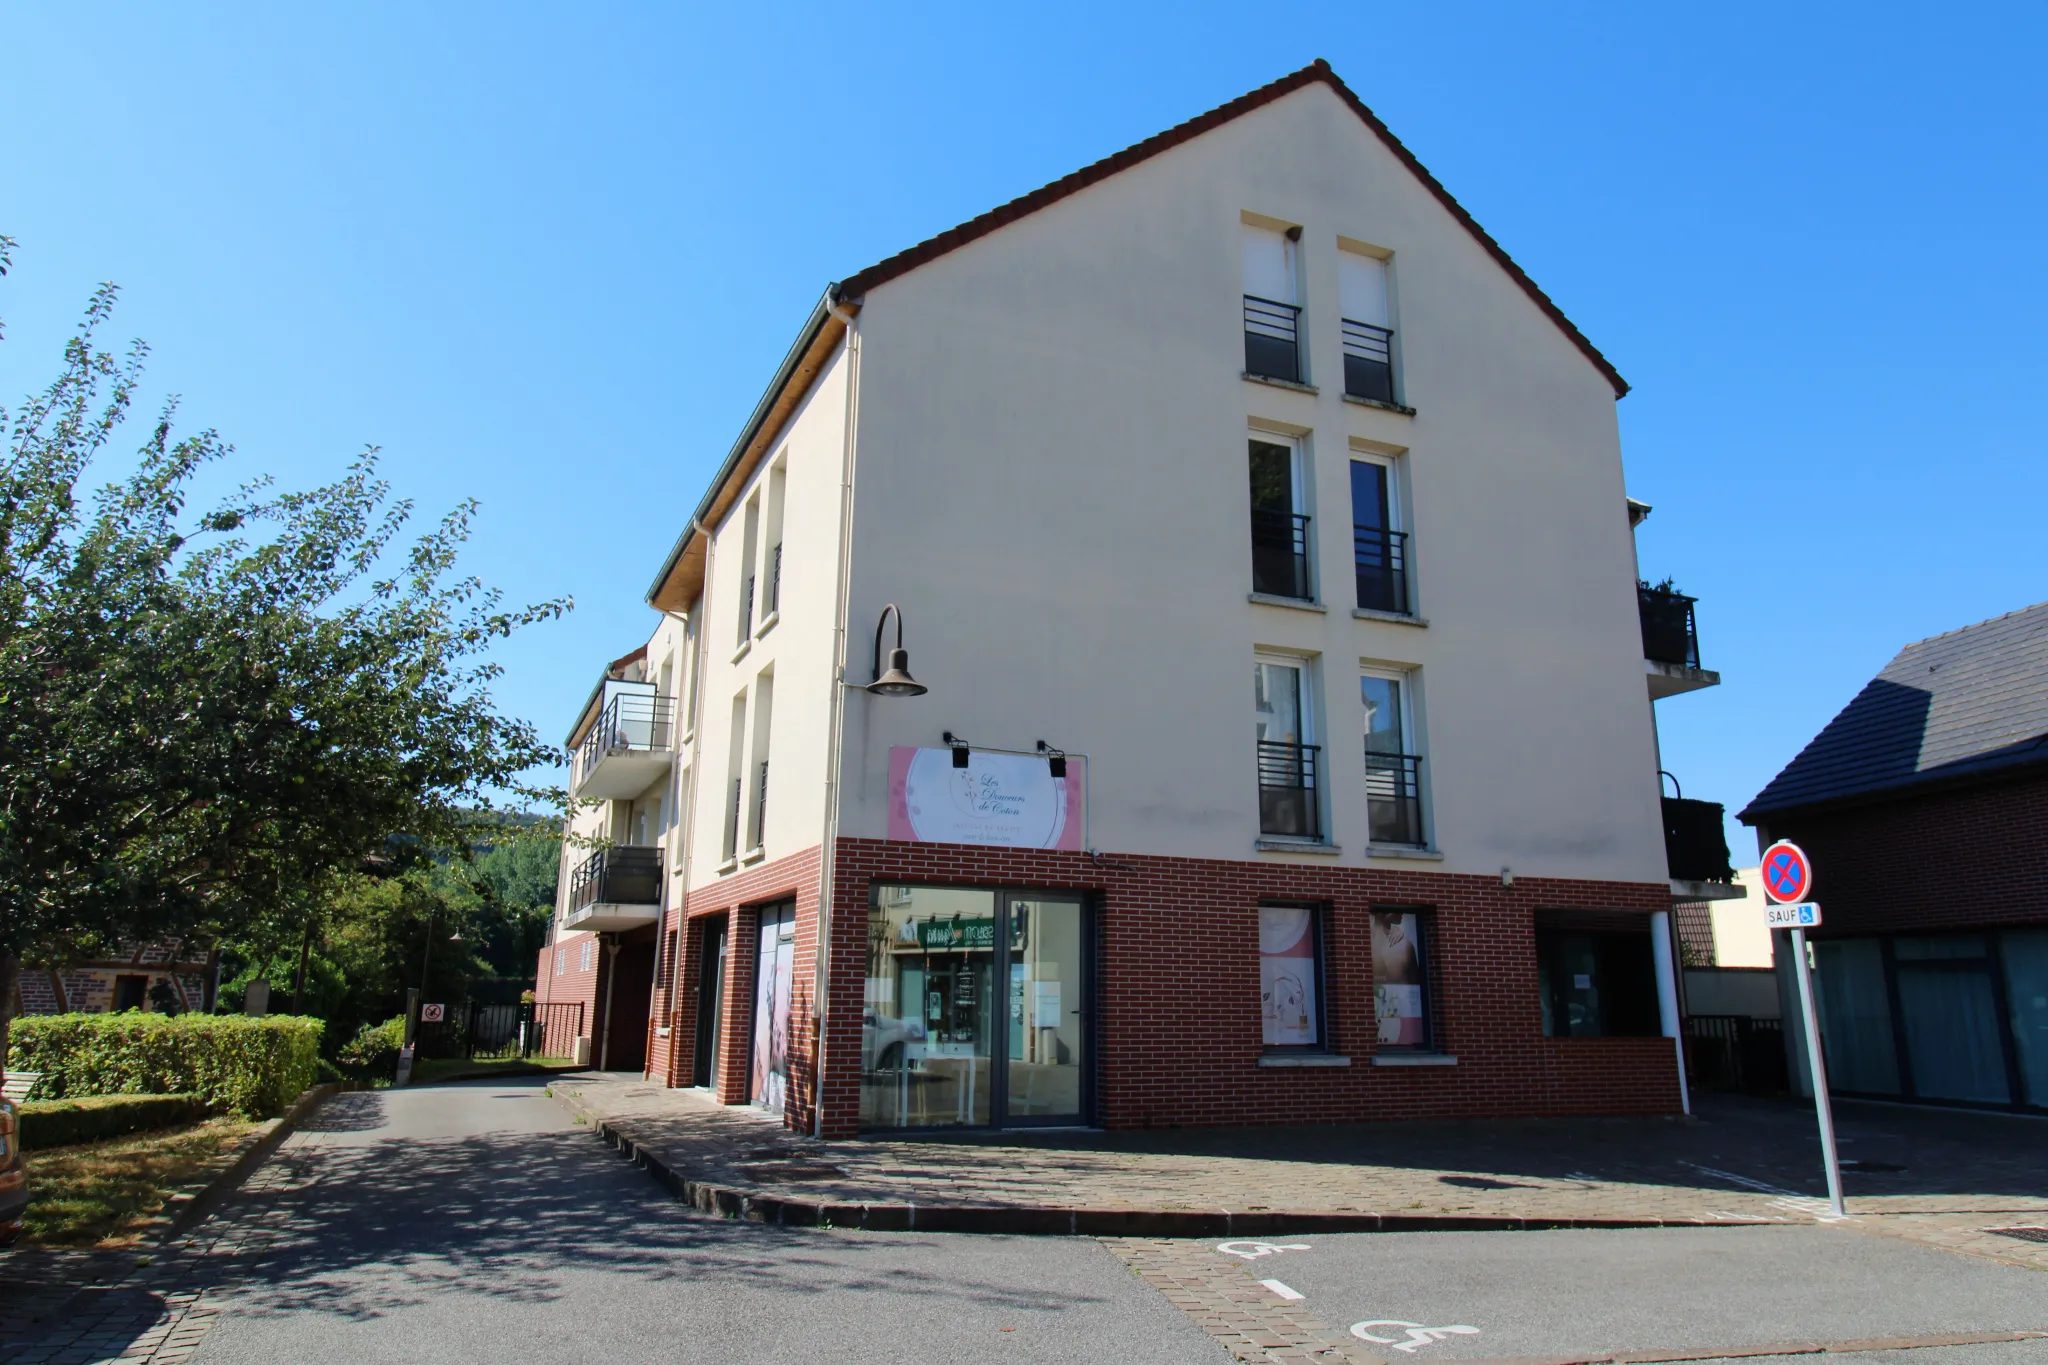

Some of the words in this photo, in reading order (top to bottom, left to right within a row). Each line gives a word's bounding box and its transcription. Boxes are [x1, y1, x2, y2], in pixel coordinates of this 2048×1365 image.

[980, 772, 999, 787] Les
[980, 787, 1025, 803] Douceurs
[978, 801, 989, 811] de
[990, 800, 1020, 815] Coton
[1768, 910, 1797, 923] SAUF
